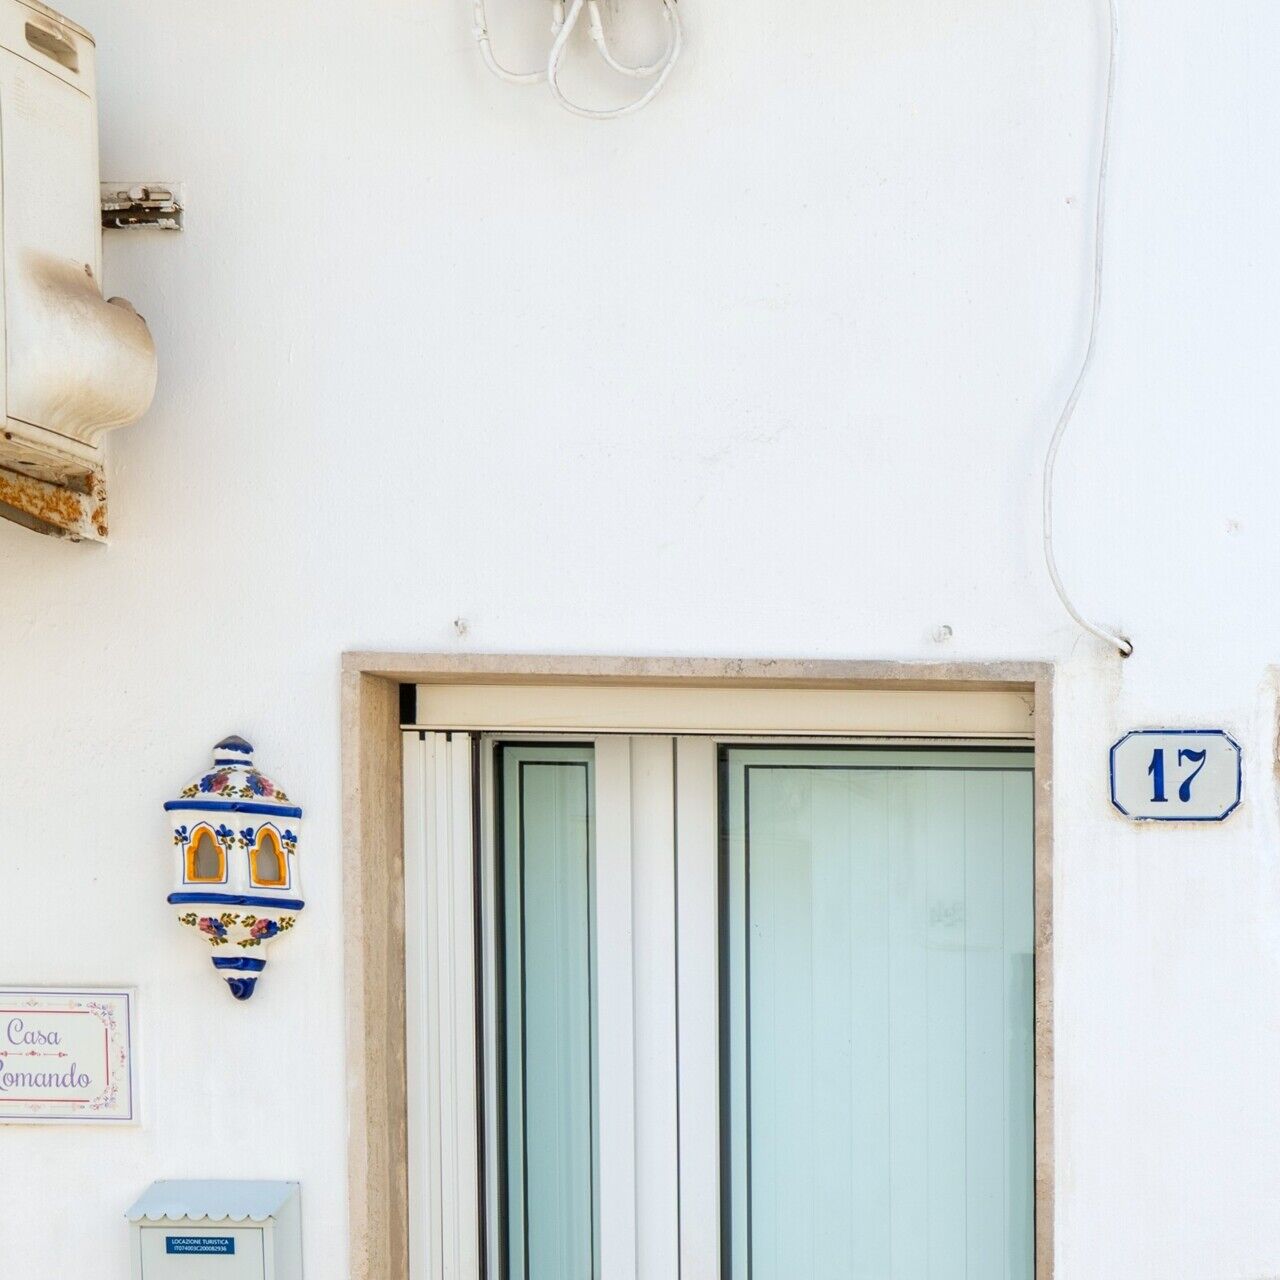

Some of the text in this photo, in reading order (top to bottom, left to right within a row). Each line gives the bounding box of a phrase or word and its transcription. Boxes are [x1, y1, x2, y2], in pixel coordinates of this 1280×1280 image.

[1148, 748, 1207, 803] 17
[7, 1017, 62, 1046] Casa
[0, 1060, 92, 1092] omando
